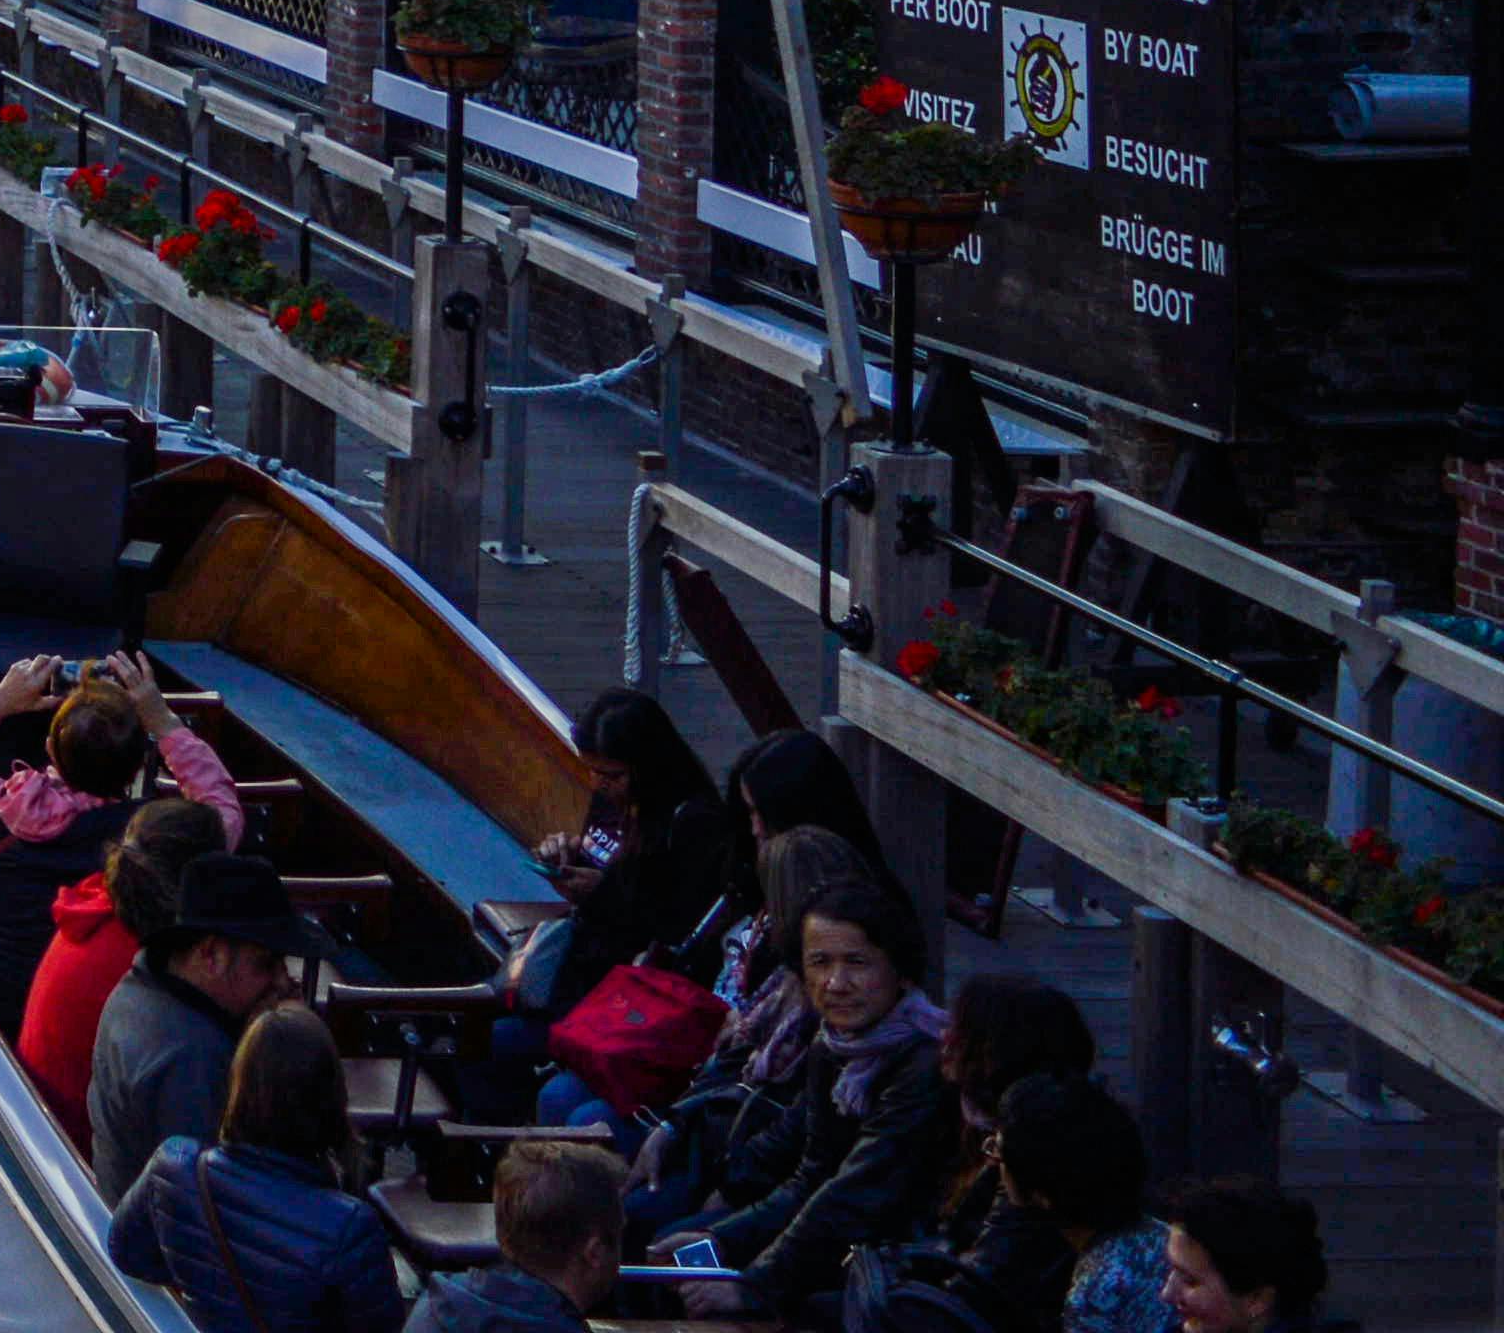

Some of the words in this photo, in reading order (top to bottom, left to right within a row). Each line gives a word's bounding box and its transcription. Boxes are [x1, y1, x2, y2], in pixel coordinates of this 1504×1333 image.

[1104, 28, 1133, 64] BY
[1139, 34, 1198, 77] BOAT
[904, 88, 977, 134] VISITEZ
[1105, 135, 1209, 190] BESUCHT
[1101, 213, 1194, 269] BRÜGGE
[1201, 238, 1226, 277] IM
[1133, 278, 1194, 325] BOOT
